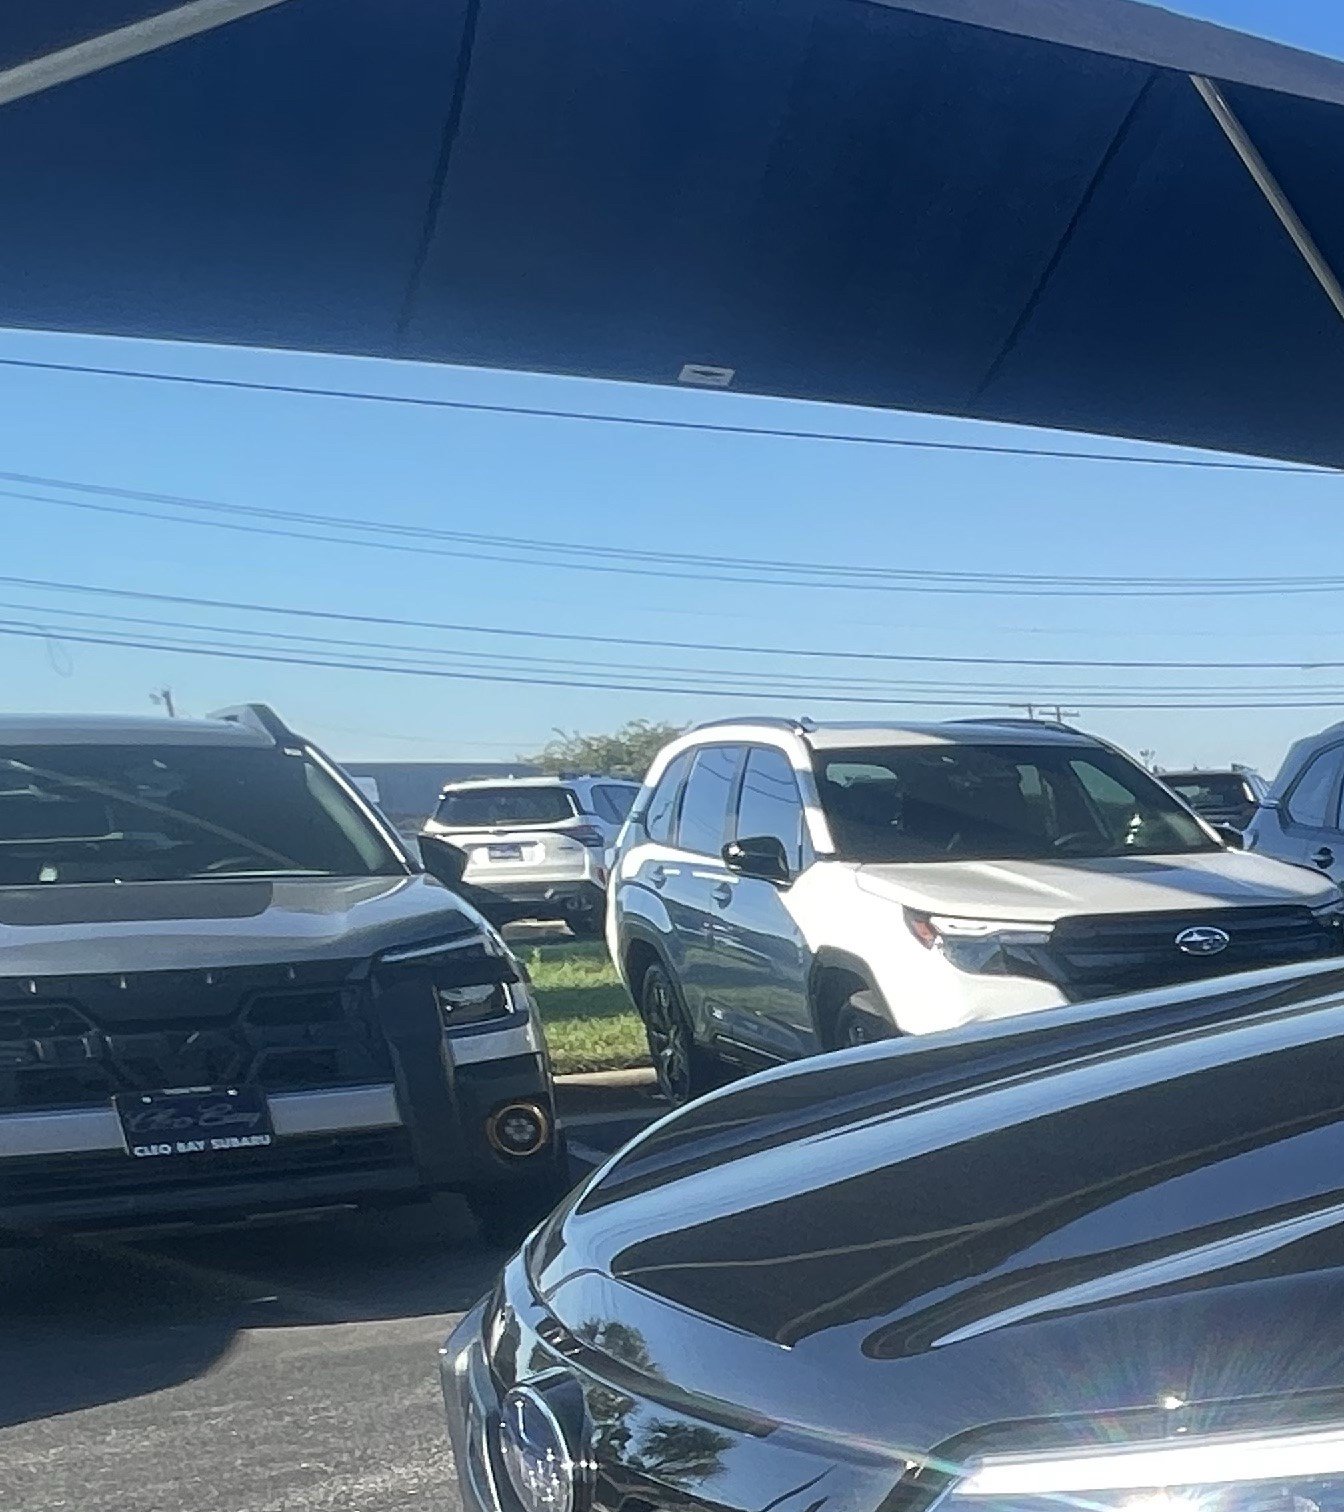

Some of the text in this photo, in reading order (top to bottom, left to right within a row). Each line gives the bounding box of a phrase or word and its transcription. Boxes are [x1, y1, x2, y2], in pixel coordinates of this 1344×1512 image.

[133, 1135, 271, 1157] CLEO BAY SUBARU
